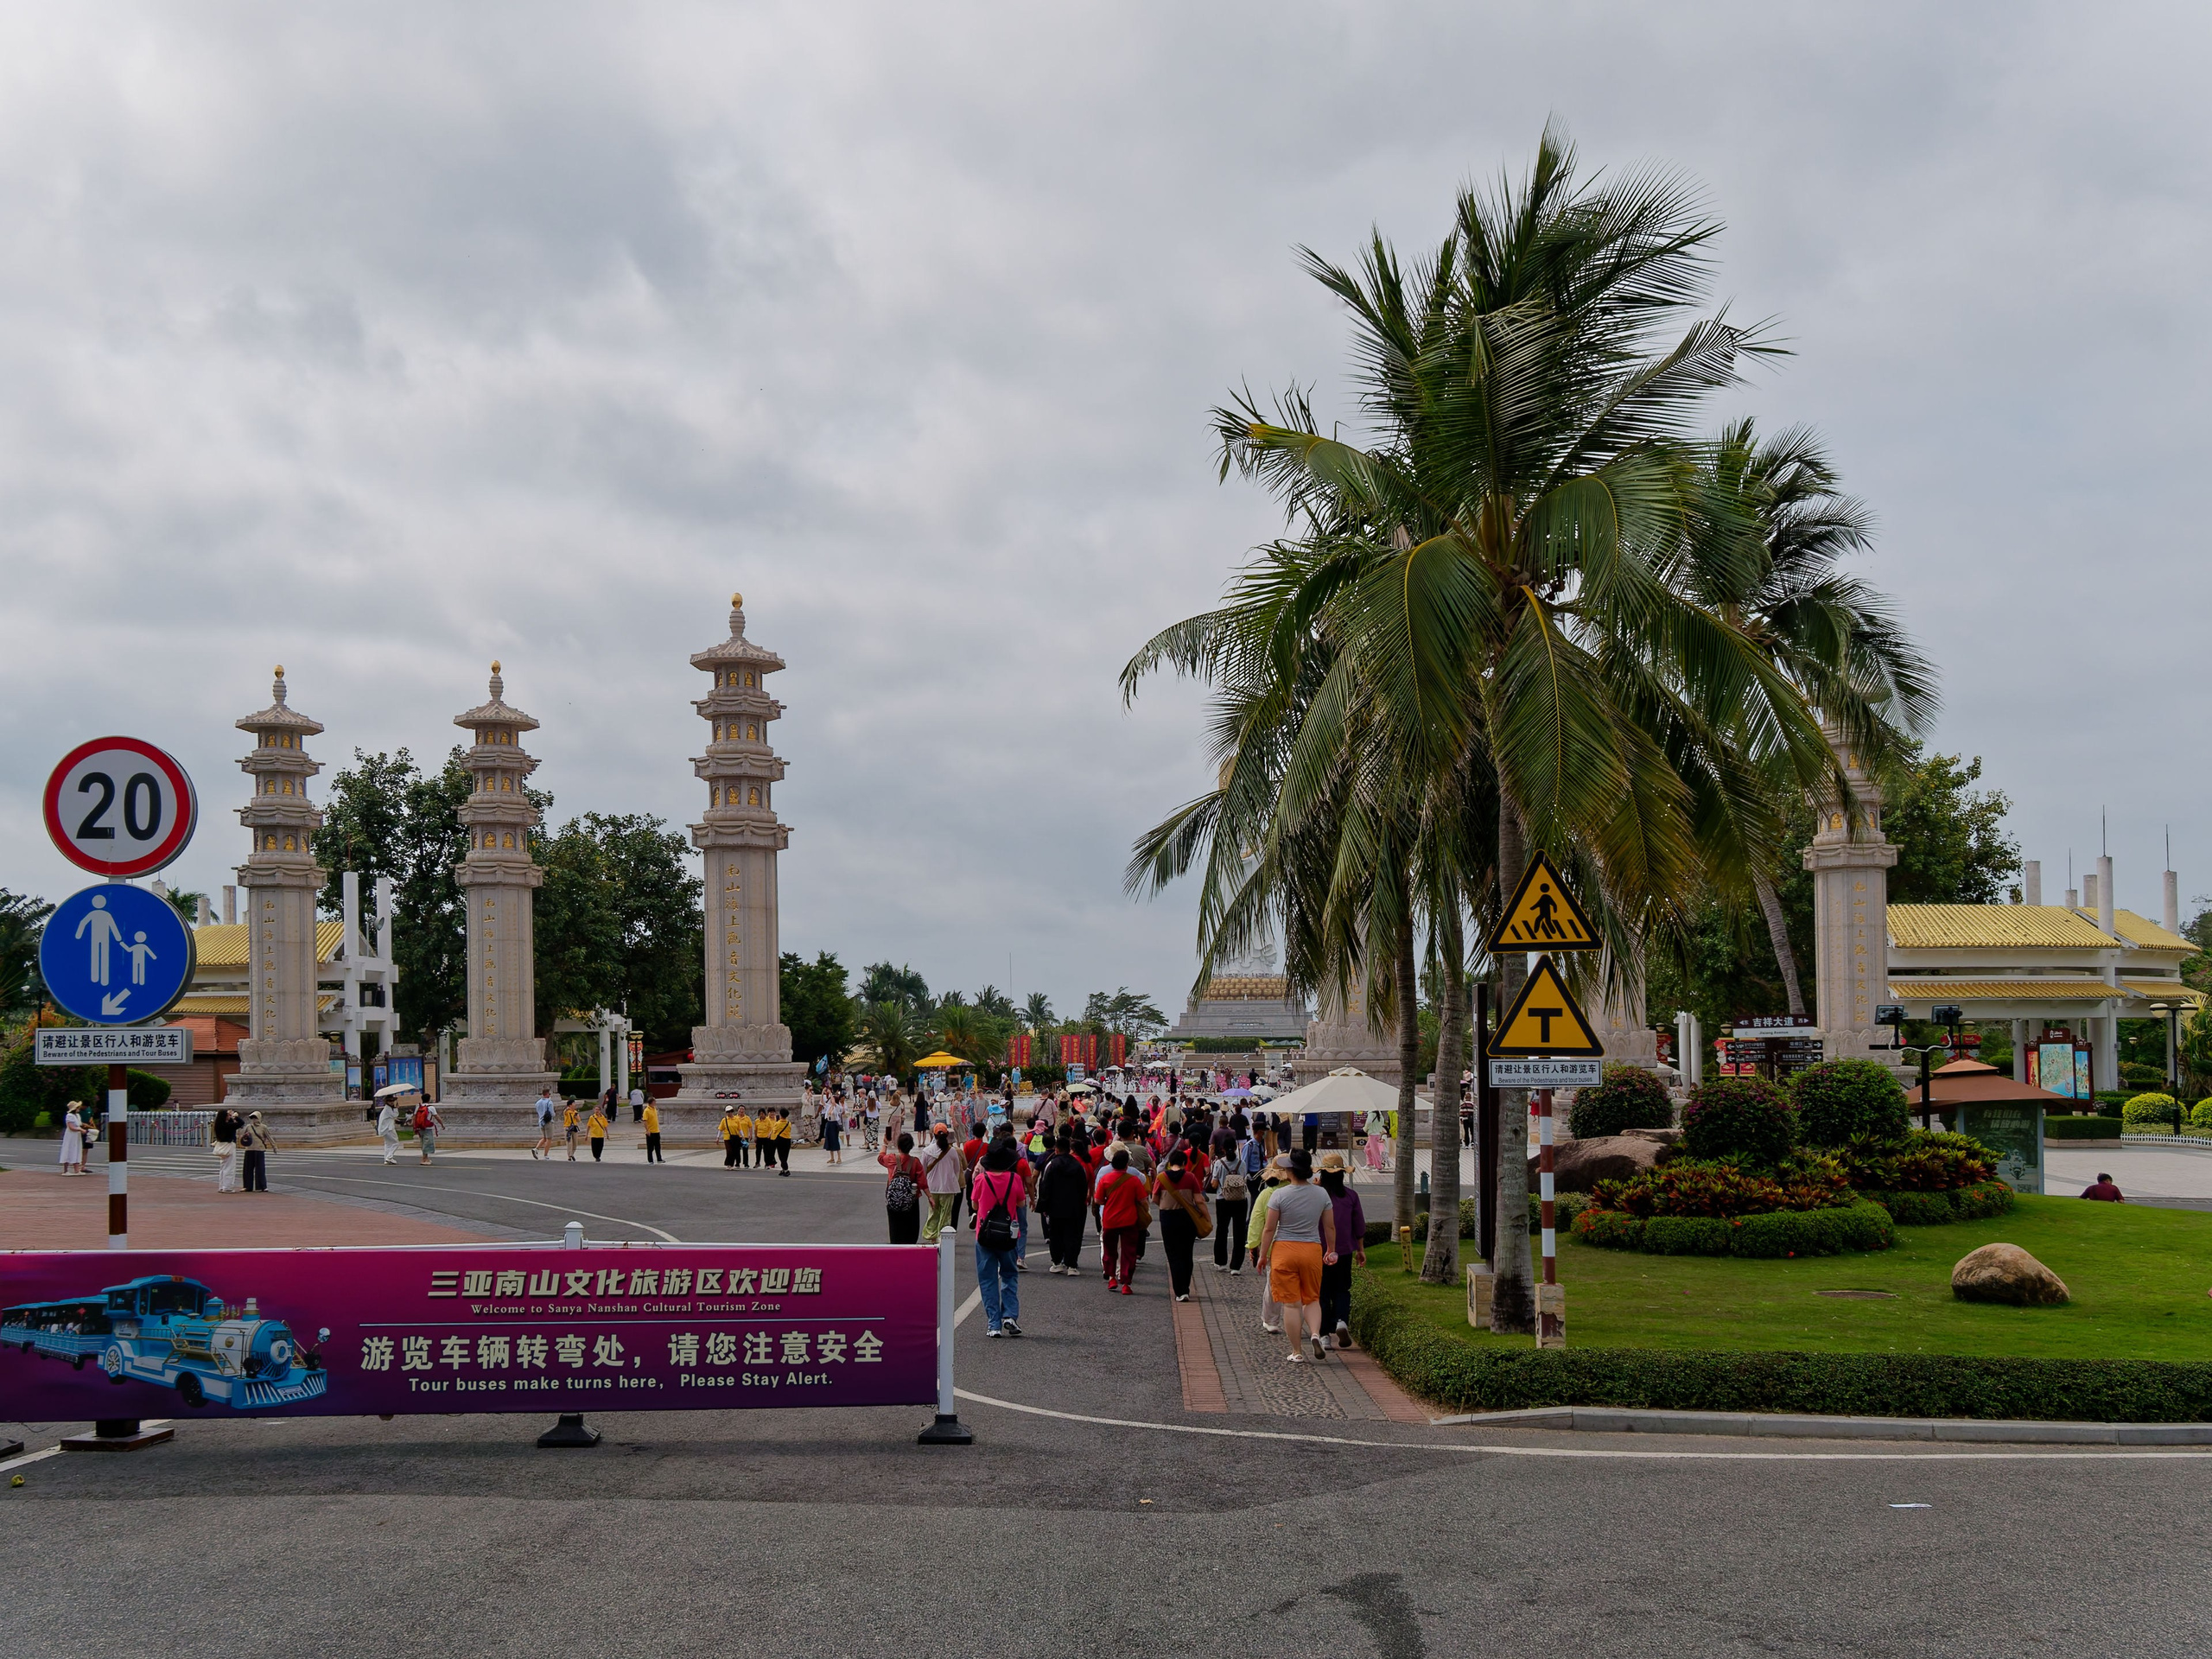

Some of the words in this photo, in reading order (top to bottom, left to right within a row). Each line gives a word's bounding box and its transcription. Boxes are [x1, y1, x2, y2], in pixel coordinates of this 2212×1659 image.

[76, 772, 162, 841] 20
[1752, 1016, 1794, 1027] 吉祥大道
[42, 1034, 179, 1048] 请避让景区行人和游览车
[1495, 1065, 1597, 1074] 请避让景区行人和游览车
[428, 1268, 822, 1297] 三亚南山文化旅游区欢迎您
[471, 1304, 525, 1314] Welcome
[531, 1305, 543, 1313] to
[548, 1303, 582, 1315] Sanya
[588, 1303, 638, 1313] Nanshan
[643, 1301, 691, 1312] Cultural
[696, 1301, 746, 1312] Tourism
[751, 1301, 781, 1311] Zone
[409, 1378, 448, 1392] Tour
[456, 1377, 506, 1391] buses
[514, 1376, 560, 1390] make
[566, 1376, 612, 1389] turns
[619, 1375, 664, 1389] here,
[680, 1374, 735, 1387] Please
[741, 1372, 779, 1389] Stay
[785, 1372, 833, 1385] Alert.
